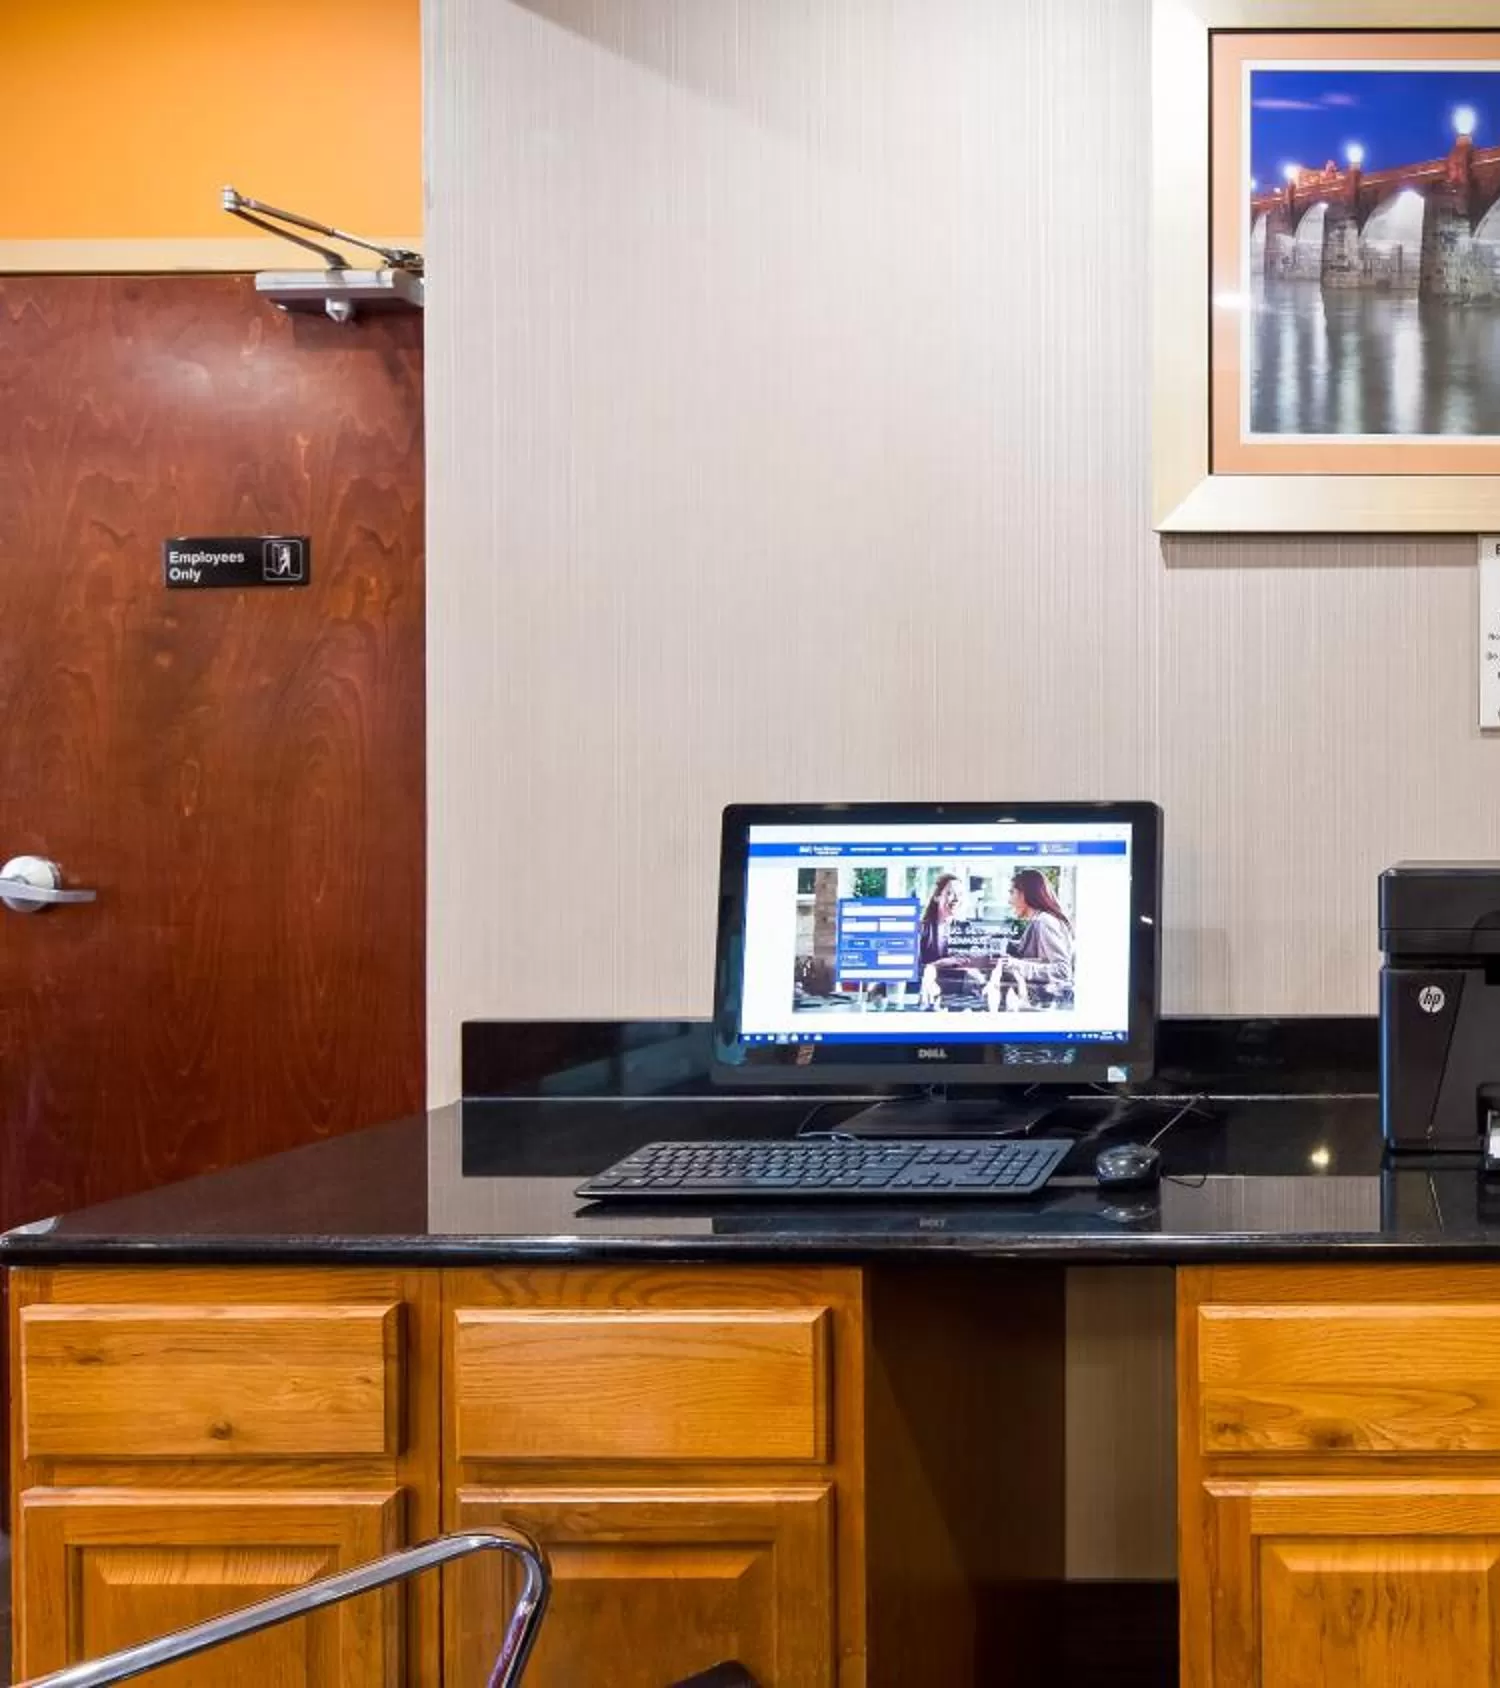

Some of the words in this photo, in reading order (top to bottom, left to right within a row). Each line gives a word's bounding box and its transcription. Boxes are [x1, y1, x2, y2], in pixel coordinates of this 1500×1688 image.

[169, 551, 245, 566] Employees
[169, 567, 201, 582] Only
[1488, 633, 1500, 641] No
[1487, 652, 1498, 660] Do
[1421, 986, 1443, 1012] hp
[918, 1048, 949, 1060] DELL
